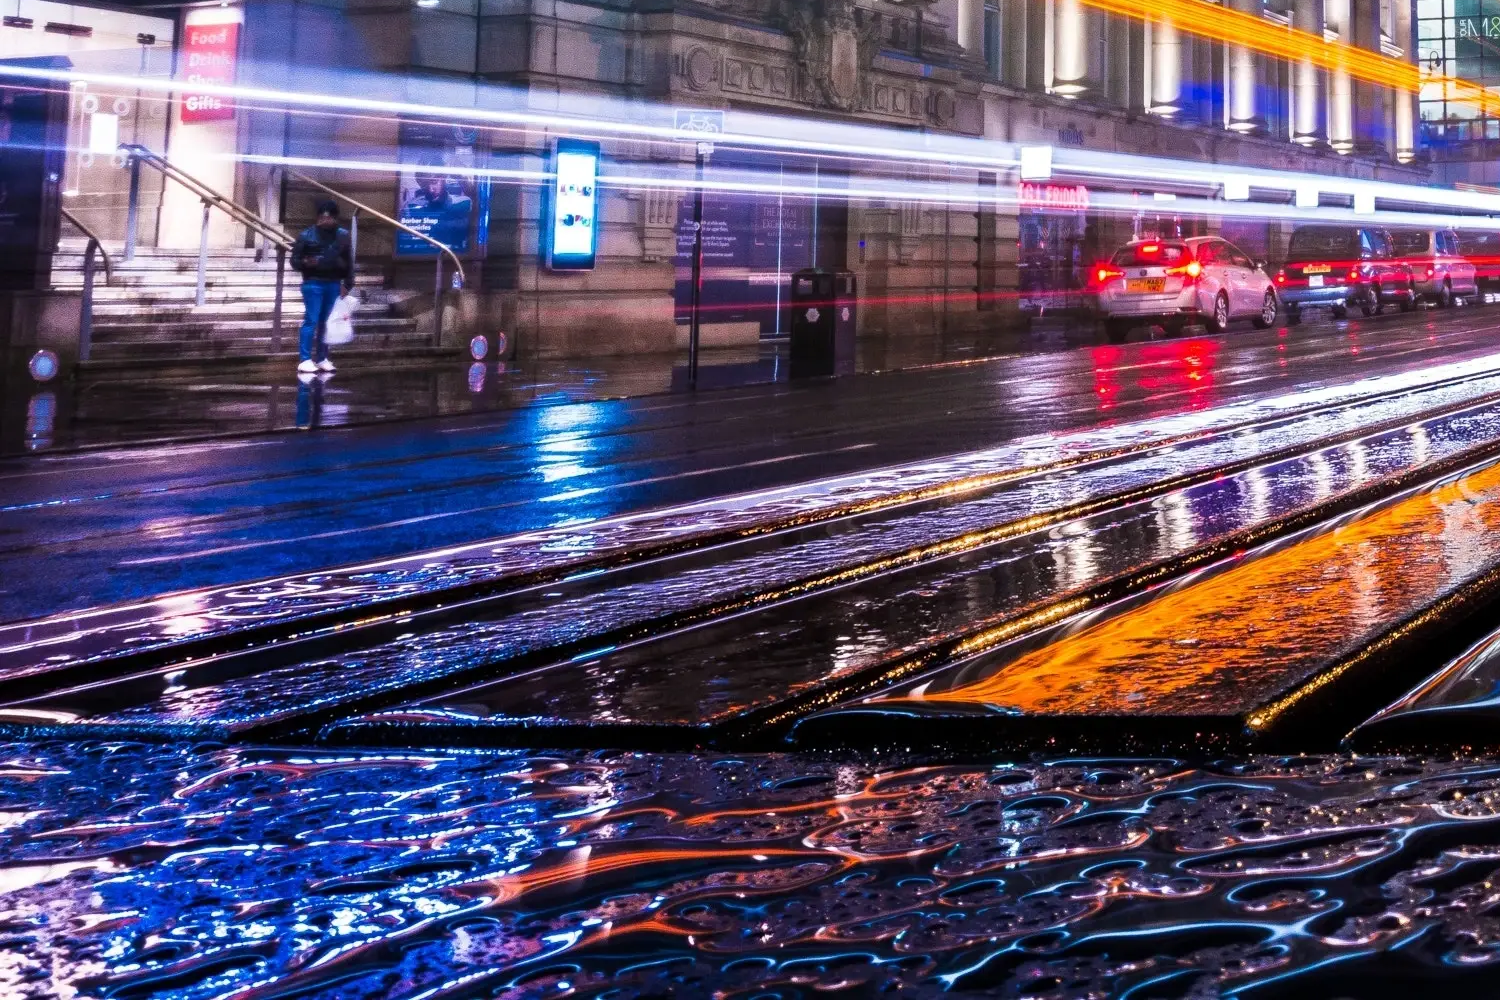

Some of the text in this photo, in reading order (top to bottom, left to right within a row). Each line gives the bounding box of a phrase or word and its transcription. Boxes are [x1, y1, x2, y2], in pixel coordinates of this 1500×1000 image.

[190, 29, 227, 45] Food
[189, 50, 231, 67] Drink
[185, 96, 221, 111] Gifts
